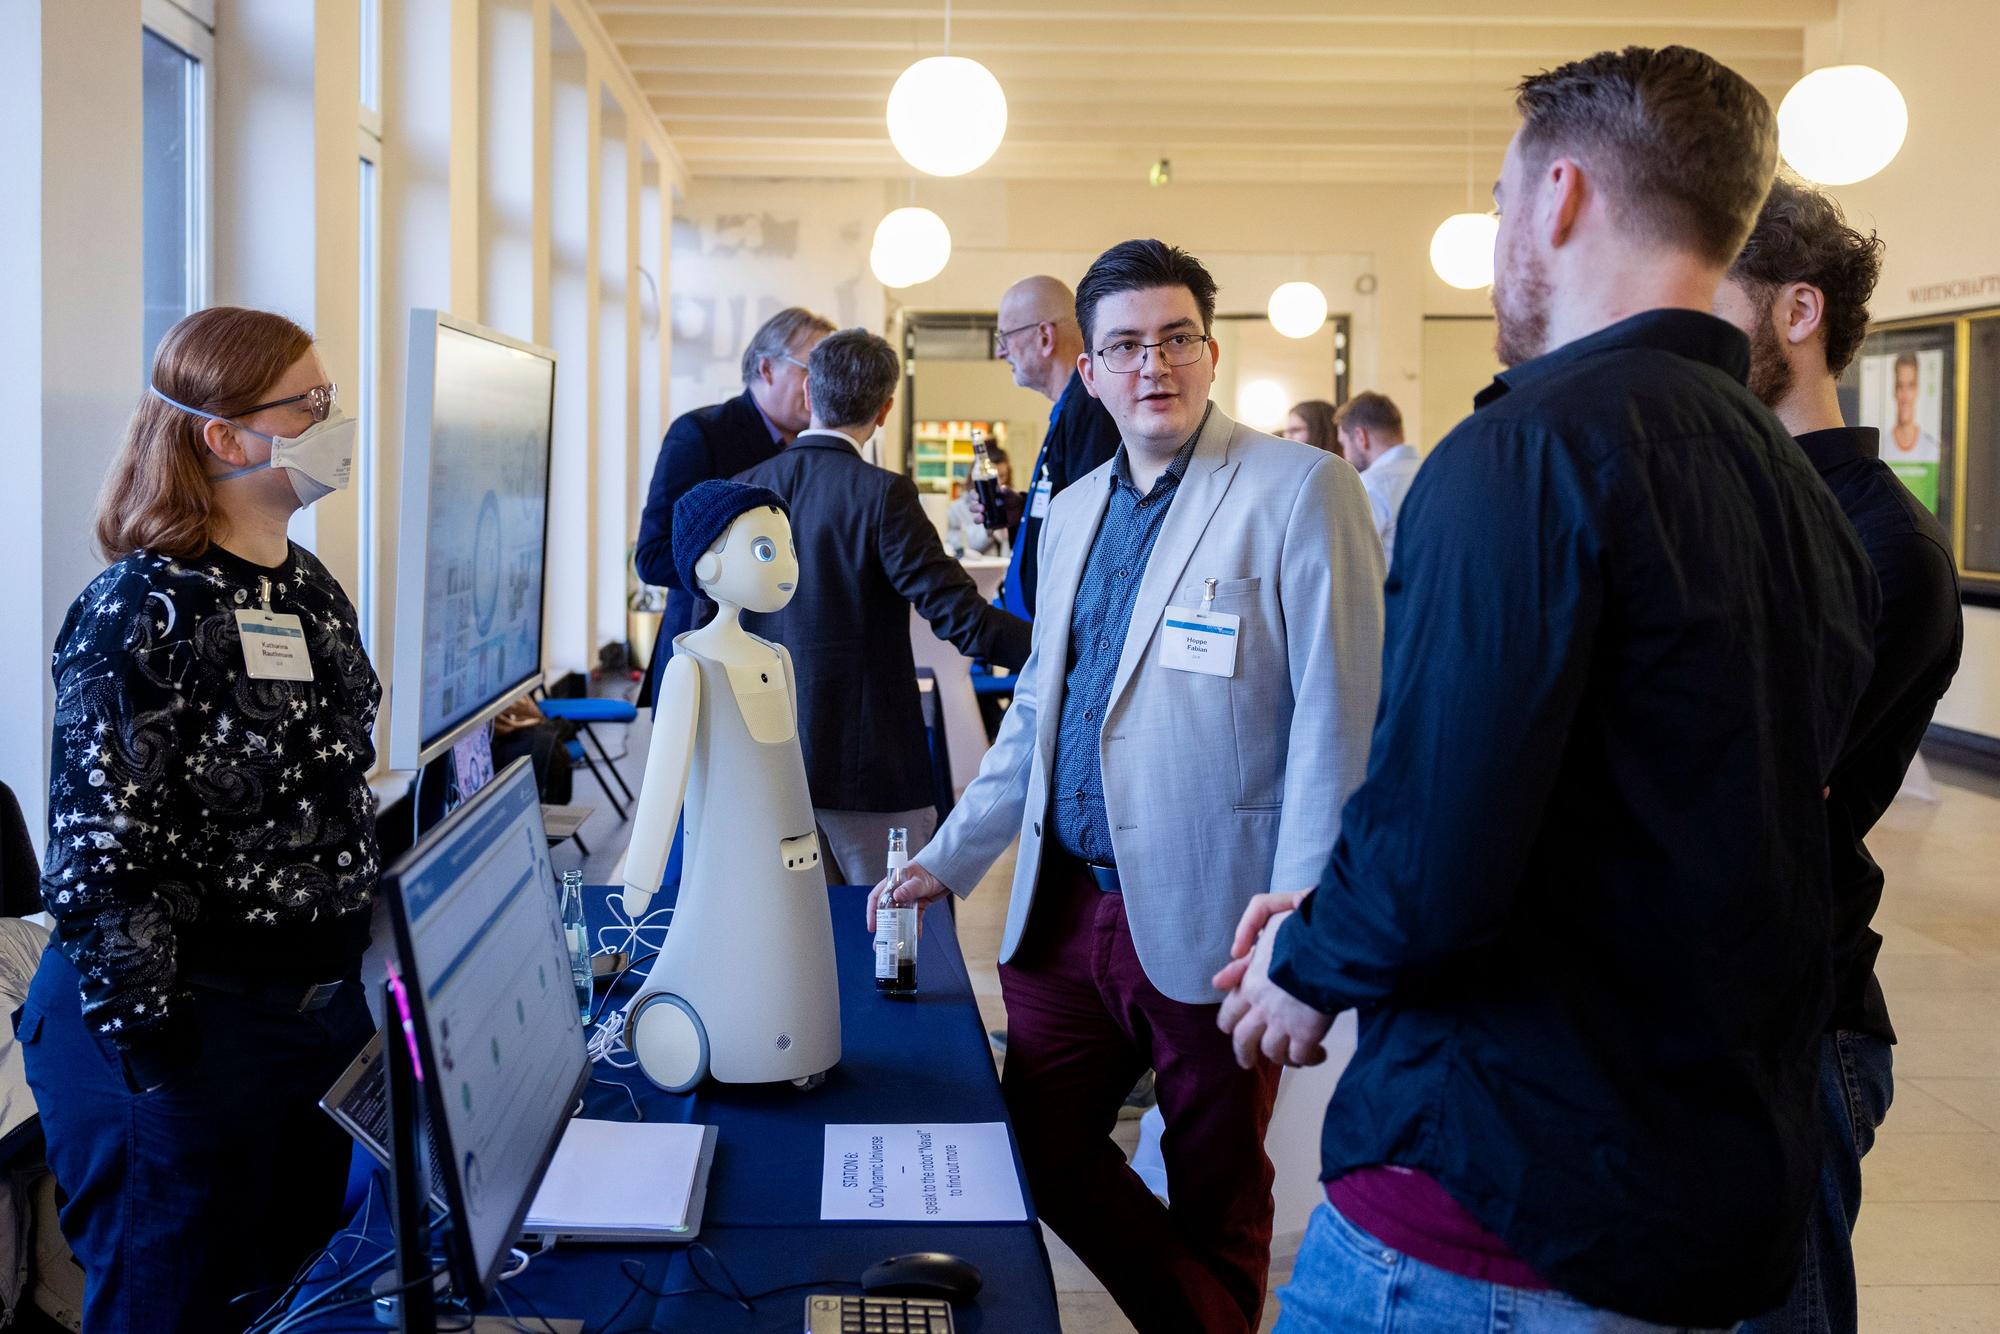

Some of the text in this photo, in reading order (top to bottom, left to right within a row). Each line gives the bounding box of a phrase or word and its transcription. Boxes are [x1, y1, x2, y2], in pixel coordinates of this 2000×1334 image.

[1187, 645, 1208, 653] Fabian
[868, 1135, 888, 1209] Our Dynamic Universe
[920, 1153, 934, 1172] robot
[945, 1144, 963, 1197] to find out more
[842, 1159, 859, 1188] STATION
[920, 1171, 936, 1184] the
[922, 1183, 937, 1192] to
[922, 1192, 941, 1215] speak
